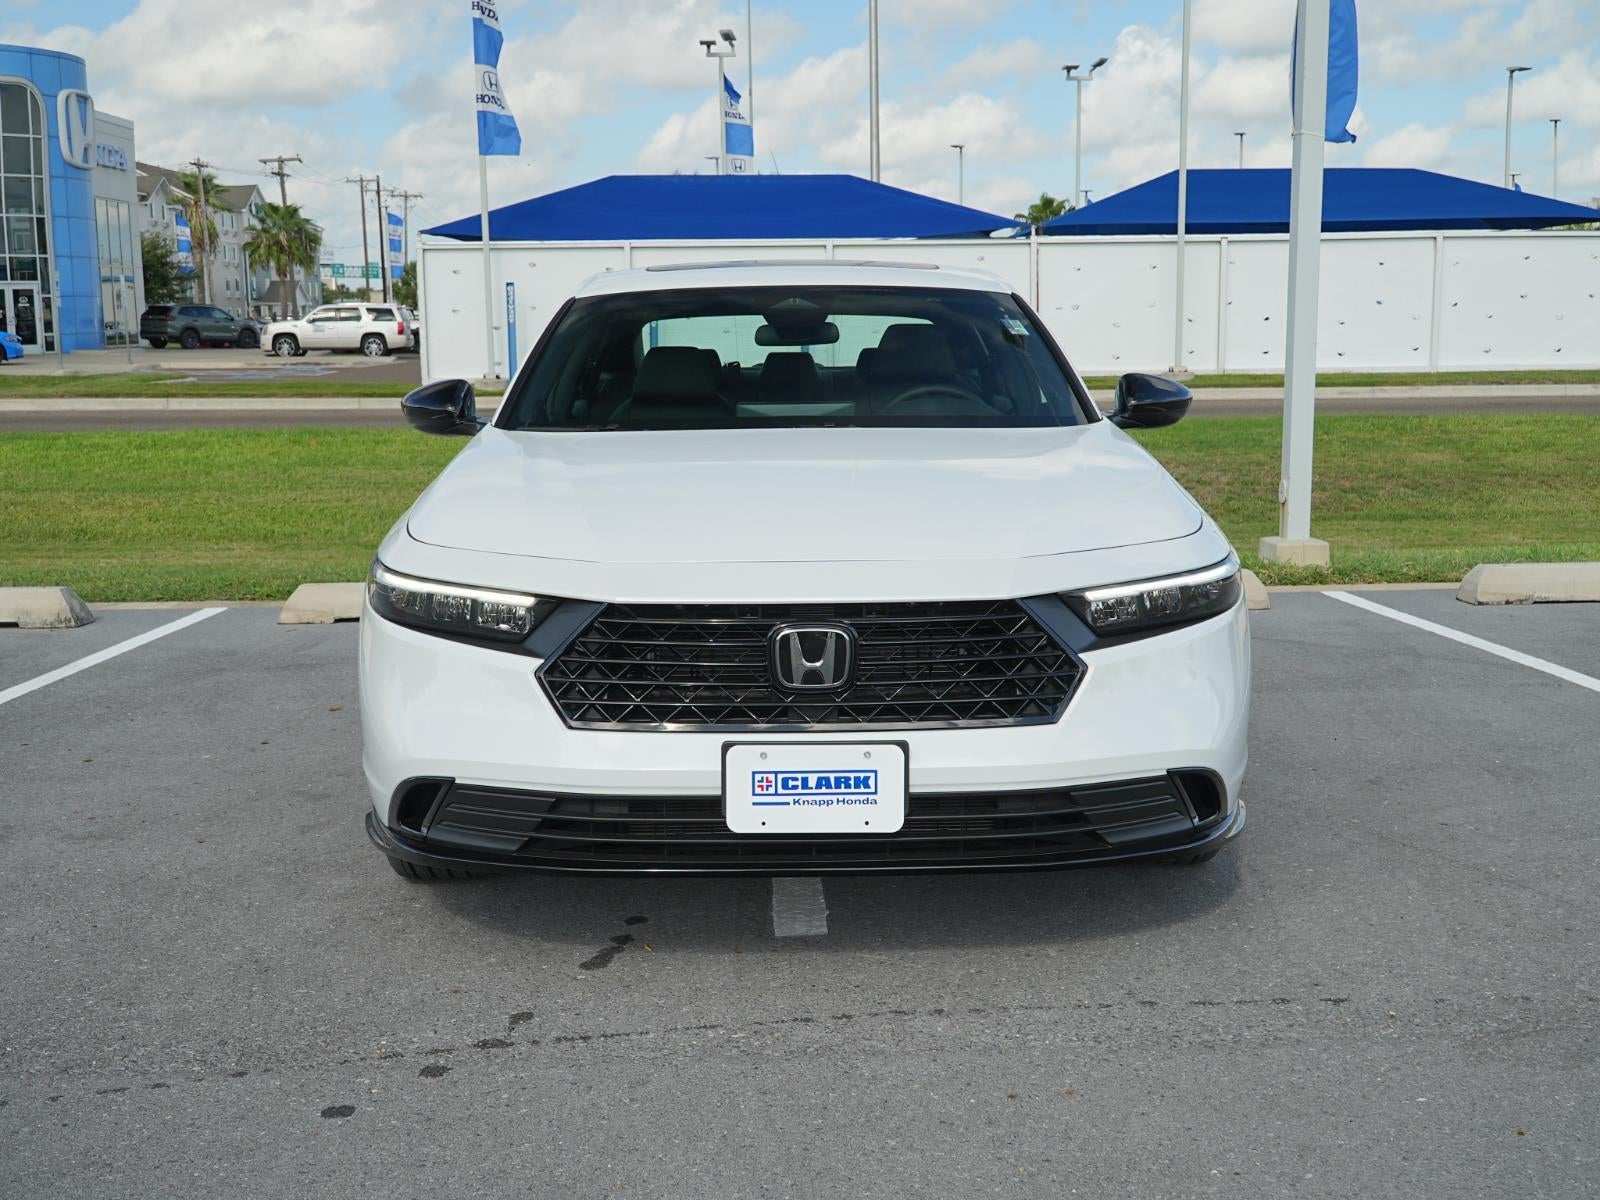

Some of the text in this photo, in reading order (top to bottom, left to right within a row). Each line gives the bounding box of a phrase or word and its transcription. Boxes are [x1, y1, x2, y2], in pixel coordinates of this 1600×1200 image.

[96, 143, 129, 170] NDA
[781, 775, 872, 791] CLARK
[792, 797, 878, 807] Knapp Honda
